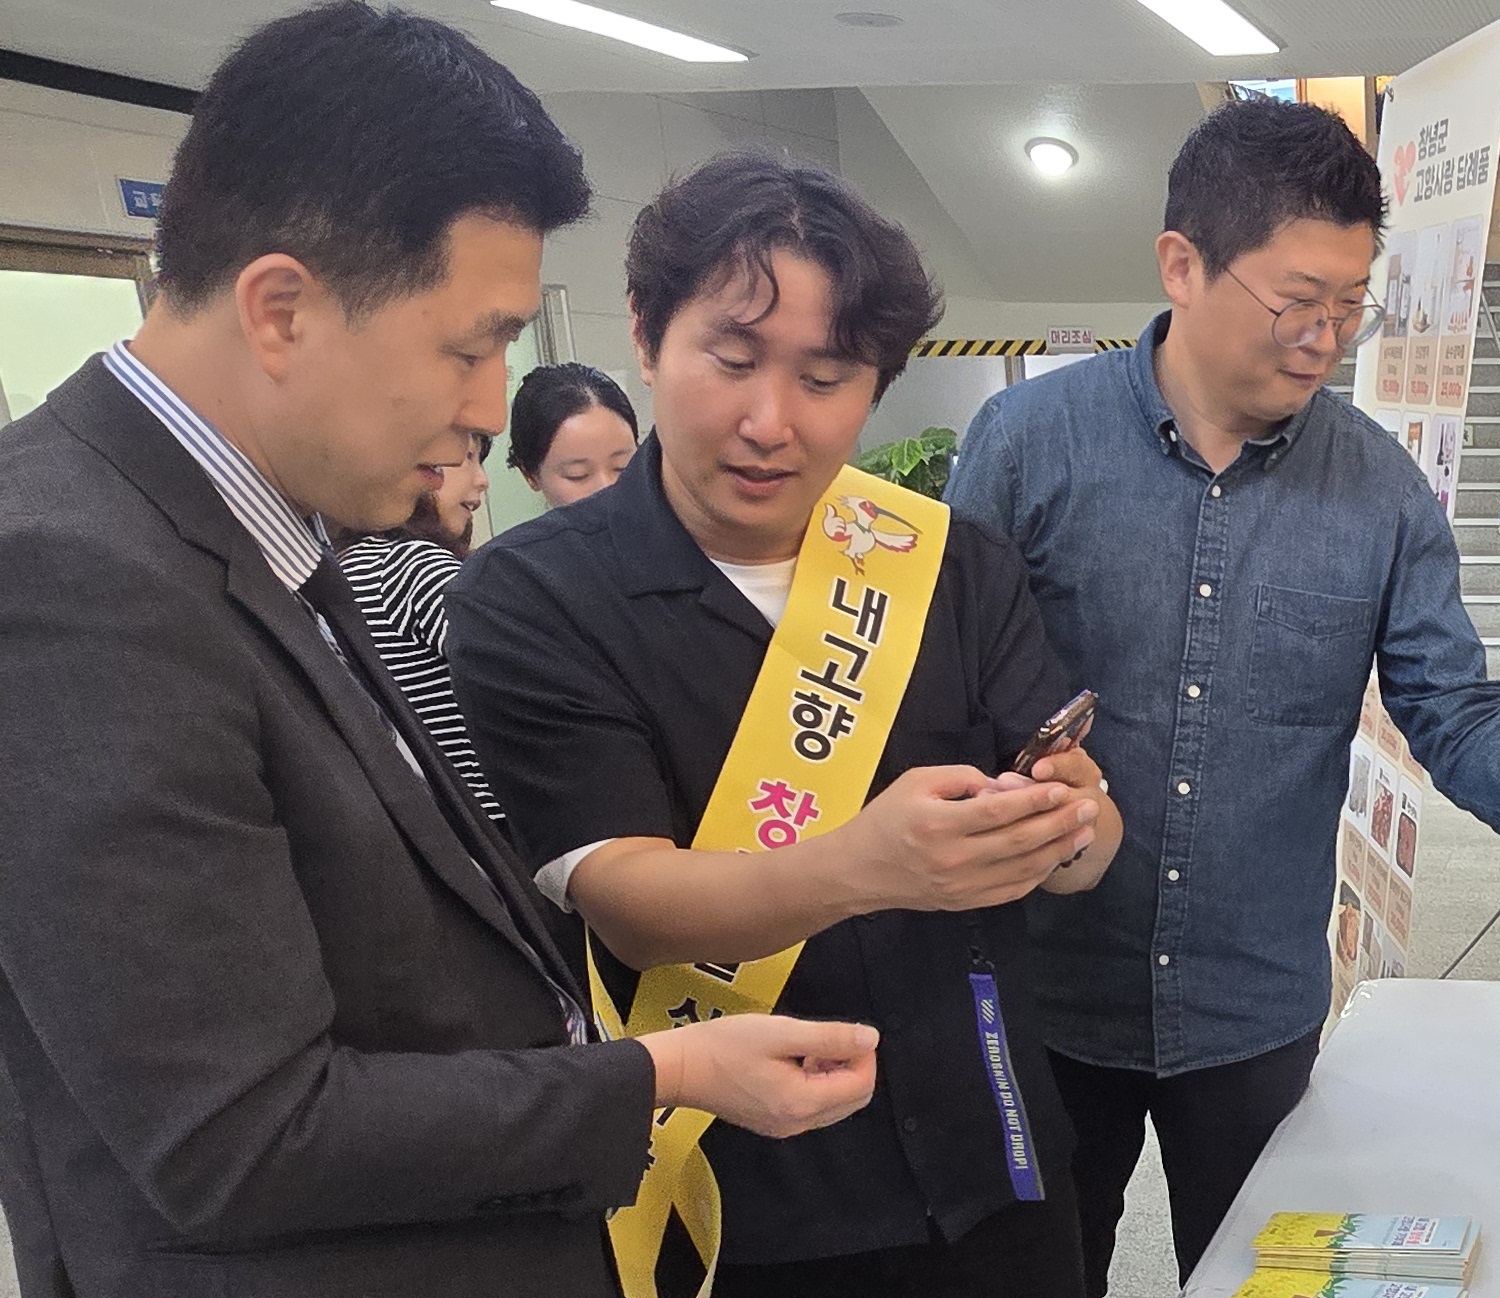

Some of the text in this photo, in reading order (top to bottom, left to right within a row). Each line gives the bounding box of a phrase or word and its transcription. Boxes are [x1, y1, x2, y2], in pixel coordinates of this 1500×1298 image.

[1418, 118, 1449, 161] 창녕군
[1413, 145, 1491, 203] 고향사랑 답례품
[1050, 329, 1092, 344] 머리조심
[1000, 1092, 1015, 1106] DO
[1005, 1109, 1022, 1131] NOT
[1011, 1134, 1028, 1169] DROP!
